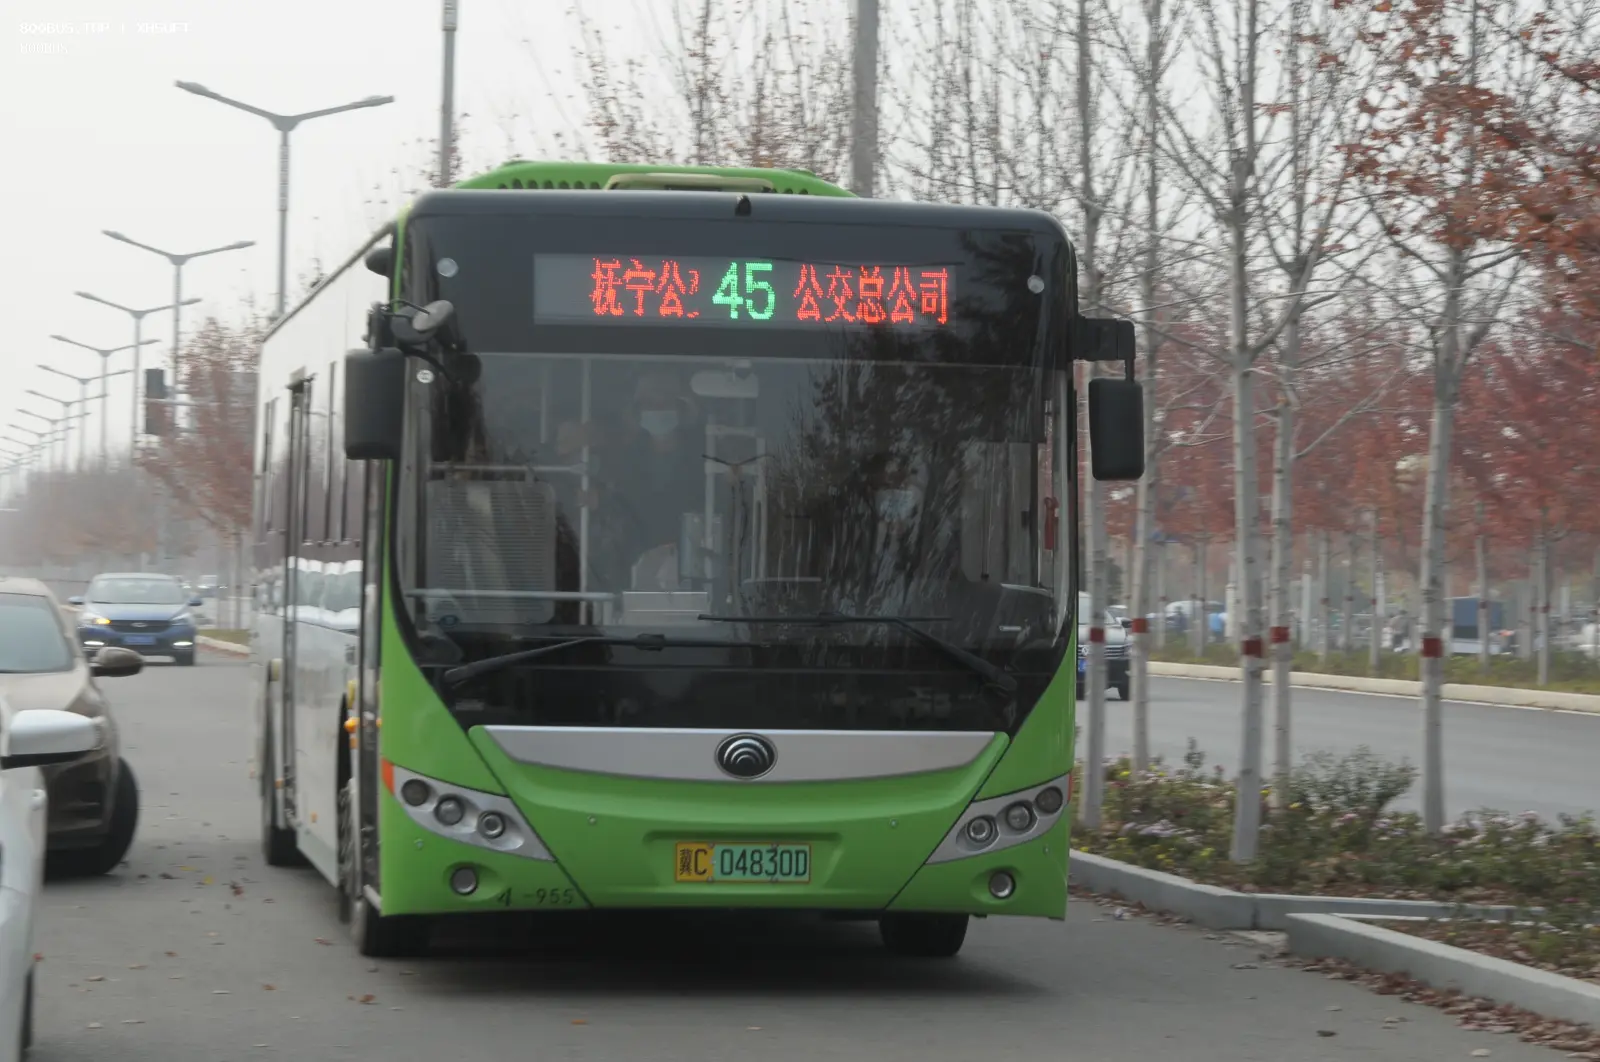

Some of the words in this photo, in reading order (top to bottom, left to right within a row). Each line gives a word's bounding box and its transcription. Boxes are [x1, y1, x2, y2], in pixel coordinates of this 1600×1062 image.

[712, 262, 776, 320] 45
[793, 264, 948, 324] 公交总公司
